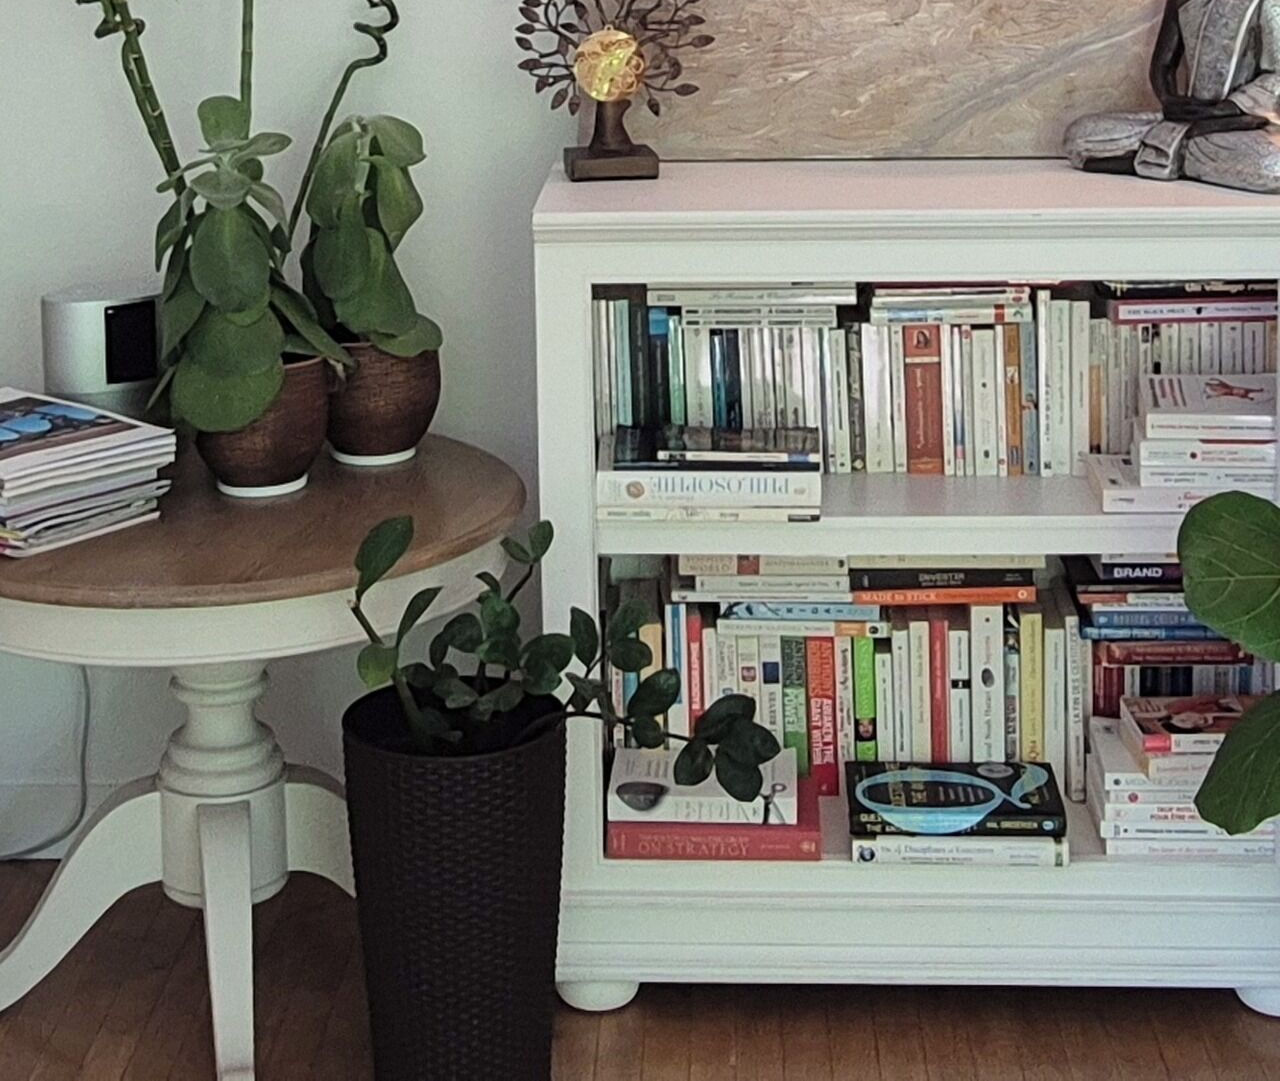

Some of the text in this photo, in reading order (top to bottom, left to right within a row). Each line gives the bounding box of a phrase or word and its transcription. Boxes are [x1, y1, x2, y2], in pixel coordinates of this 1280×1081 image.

[650, 476, 790, 494] PHILOSOPHIE
[1113, 567, 1163, 578] BRAND
[861, 593, 892, 603] MADE
[906, 592, 937, 601] STICK
[718, 641, 727, 681] DIAMOND
[821, 640, 832, 696] ANTHONY
[1071, 678, 1080, 694] DES
[785, 689, 796, 732] POWER
[1072, 697, 1080, 711] FIN
[1072, 712, 1081, 723] LA
[822, 699, 834, 764] AWAKEN THE
[812, 729, 823, 765] WITHIN
[638, 842, 749, 858] ON STRATEGY
[904, 845, 945, 856] Disciplines
